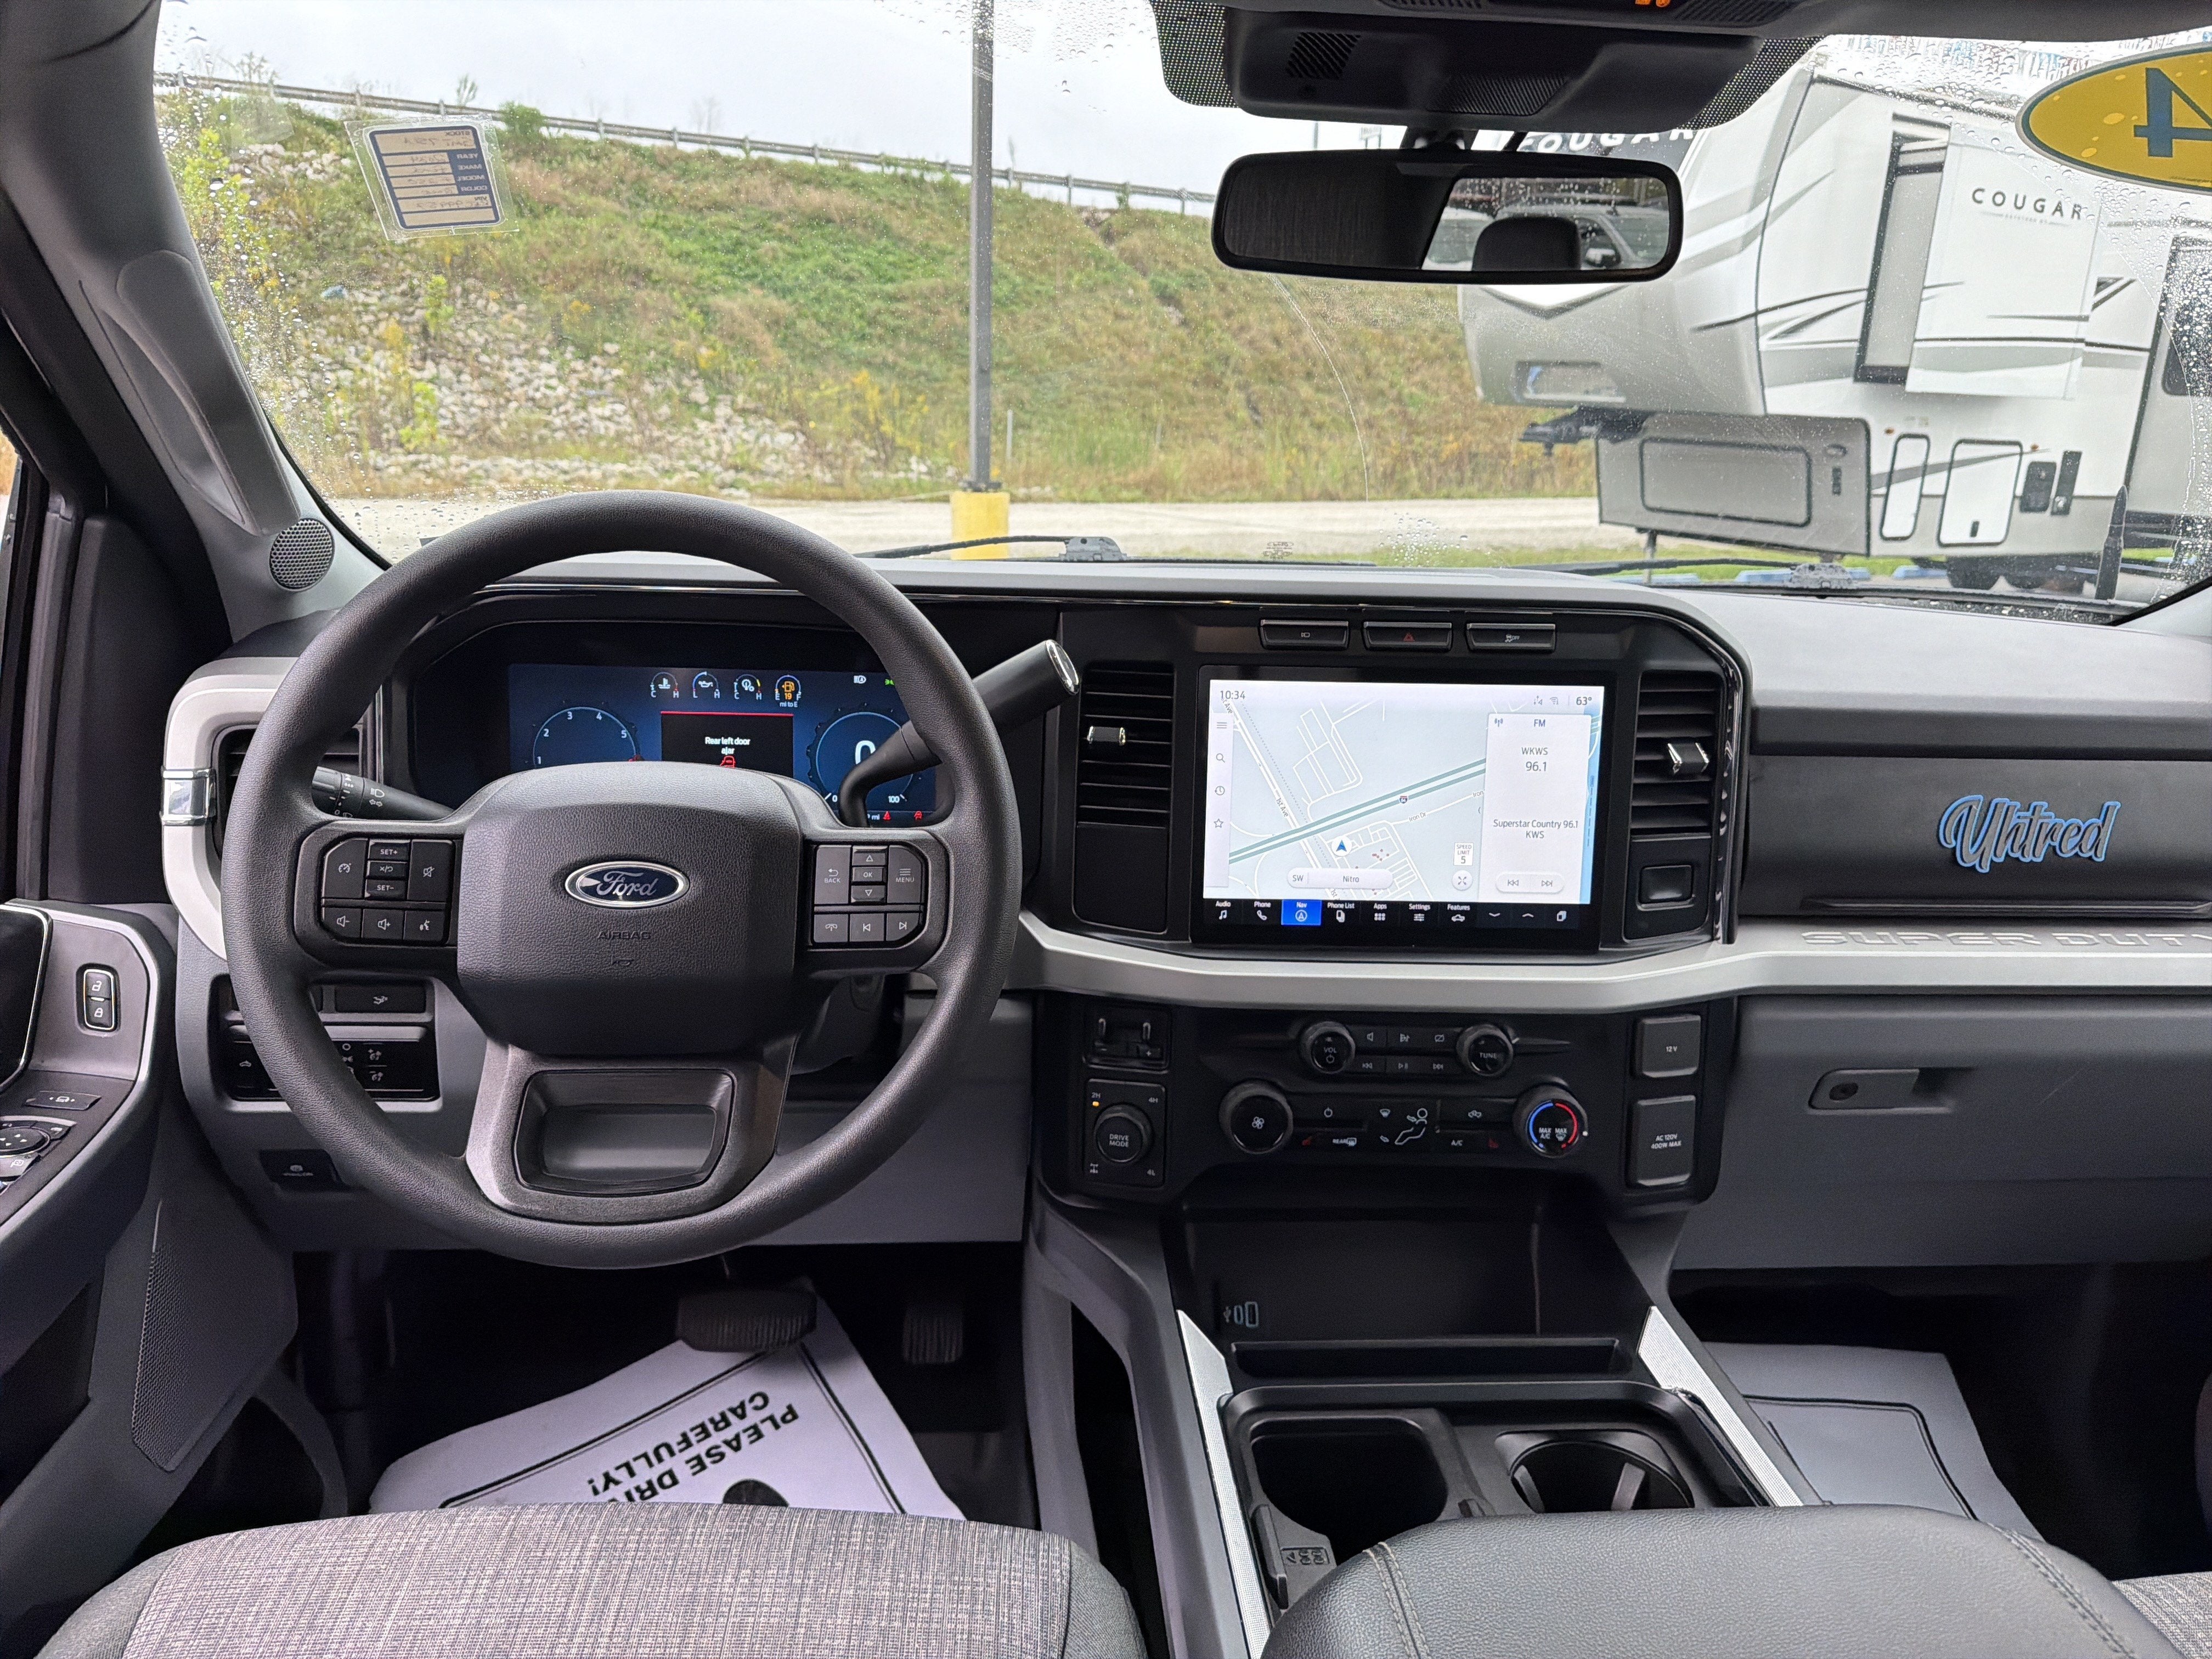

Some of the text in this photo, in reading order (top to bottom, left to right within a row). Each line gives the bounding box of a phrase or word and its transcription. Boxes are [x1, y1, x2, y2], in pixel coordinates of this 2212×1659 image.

[1972, 188, 2081, 219] COUGAR
[673, 690, 679, 698] H
[714, 691, 720, 699] H
[1220, 690, 1246, 699] 10:34
[1576, 696, 1592, 706] 63°
[567, 712, 573, 720] 3
[596, 712, 602, 720] 4
[543, 729, 549, 737] 2
[621, 730, 627, 738] 5
[705, 736, 751, 746] Rear left door
[721, 747, 735, 755] ajar
[1521, 747, 1548, 755] WKWS
[537, 756, 541, 765] 1
[1526, 761, 1547, 772] 96.1
[1408, 814, 1420, 822] Iron
[1493, 819, 1578, 830] Superstar Country 96.1
[1460, 856, 1466, 864] 5
[596, 871, 658, 896] Ford
[1408, 903, 1430, 911] Settings
[597, 931, 651, 940] AIRBAG
[1802, 931, 2042, 947] SUPER
[1109, 1140, 1129, 1148] MODE
[586, 1390, 770, 1498] CAREFULLY!
[607, 1403, 800, 1503] PLEASE DRI
